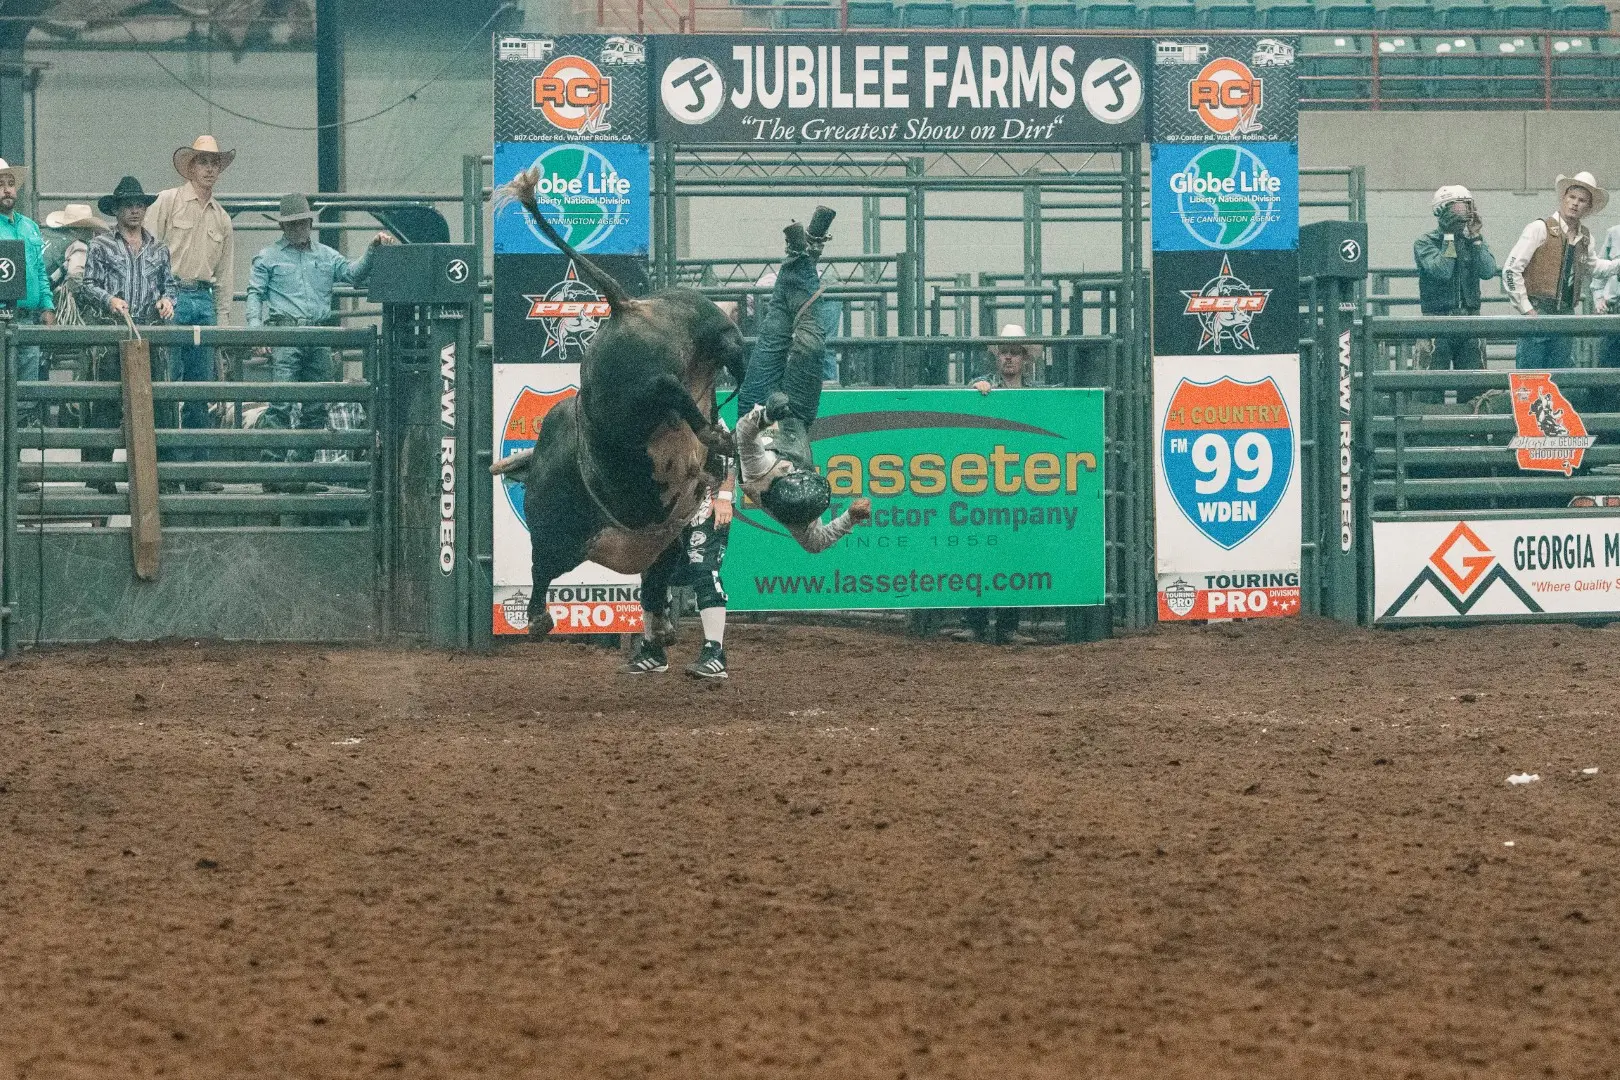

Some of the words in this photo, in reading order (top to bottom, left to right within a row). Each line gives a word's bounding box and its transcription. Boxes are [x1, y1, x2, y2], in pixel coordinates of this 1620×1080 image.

[731, 45, 910, 109] JUBILEE
[924, 45, 1076, 109] FARMS
[742, 115, 796, 140] “The
[801, 118, 899, 141] Greatest
[904, 117, 965, 141] Show
[970, 125, 995, 140] on
[595, 134, 621, 142] Robins,
[588, 171, 631, 195] Life
[1169, 171, 1236, 194] Globe
[1240, 169, 1281, 192] Life
[537, 196, 562, 206] iberty
[564, 196, 598, 205] National
[599, 196, 631, 205] Division
[1189, 195, 1217, 205] Liberty
[1218, 195, 1250, 203] National
[1251, 194, 1281, 203] Division
[547, 217, 596, 225] ANNINGTON
[597, 217, 630, 225] AGENCY
[1181, 216, 1195, 224] THE
[1196, 215, 1248, 224] CANNINGTON
[1249, 215, 1281, 223] AGENCY
[532, 302, 611, 315] PBR
[1190, 297, 1262, 310] PBR
[1170, 407, 1186, 425] #1
[1190, 404, 1282, 425] COUNTRY
[1170, 438, 1188, 454] FM
[1558, 436, 1589, 447] GEORGIA
[1191, 431, 1273, 495] 99
[1529, 448, 1576, 459] SHOOTOUT
[815, 445, 1097, 497] asseter
[1340, 420, 1352, 555] RODEO
[440, 436, 455, 576] RODEO
[1197, 500, 1257, 523] WDEN
[949, 501, 1079, 532] Company
[843, 535, 910, 549] INCE
[1513, 533, 1596, 572] GEORGIA
[754, 567, 1053, 598] www.lassetereq.com
[1204, 572, 1299, 589] TOURING
[1531, 580, 1570, 593] "Where
[1574, 579, 1612, 593] Quality
[1169, 598, 1193, 607] PRO
[1207, 590, 1268, 613] PRO
[1269, 589, 1299, 597] DIVISION
[549, 604, 615, 627] PRO
